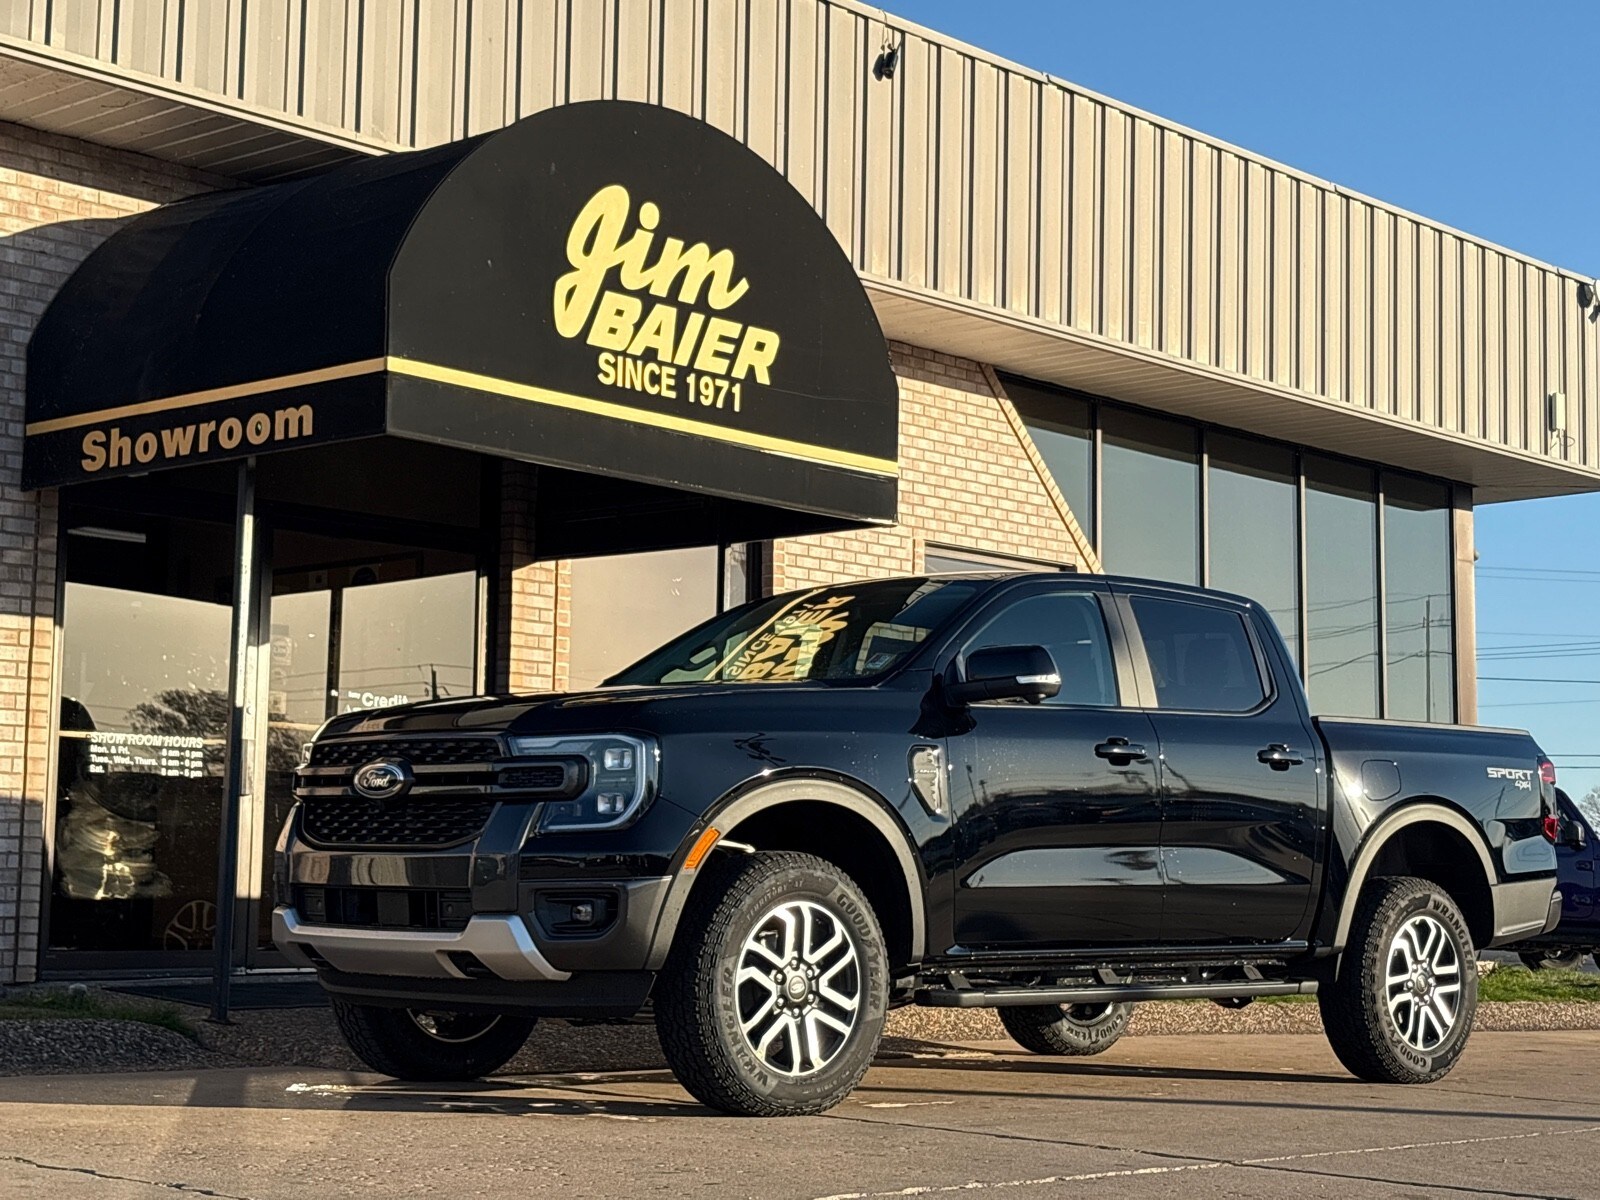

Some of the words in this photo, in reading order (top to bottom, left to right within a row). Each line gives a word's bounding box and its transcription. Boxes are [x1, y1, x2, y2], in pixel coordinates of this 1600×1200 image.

[554, 185, 749, 338] Jim
[586, 290, 780, 386] BAIER
[598, 352, 677, 399] SINCE
[686, 374, 742, 412] 1971
[82, 404, 313, 471] Showroom
[362, 692, 409, 707] Credit
[163, 736, 203, 748] HOURS
[90, 745, 108, 753] Mon.
[118, 746, 130, 754] Fri.
[191, 751, 203, 759] pm
[134, 756, 158, 765] Thurs.
[90, 764, 104, 773] Sat.
[1486, 767, 1534, 780] SPORT
[363, 769, 391, 788] Ford
[1431, 899, 1475, 971] WRANGLER
[721, 966, 769, 1089] WRANGLER
